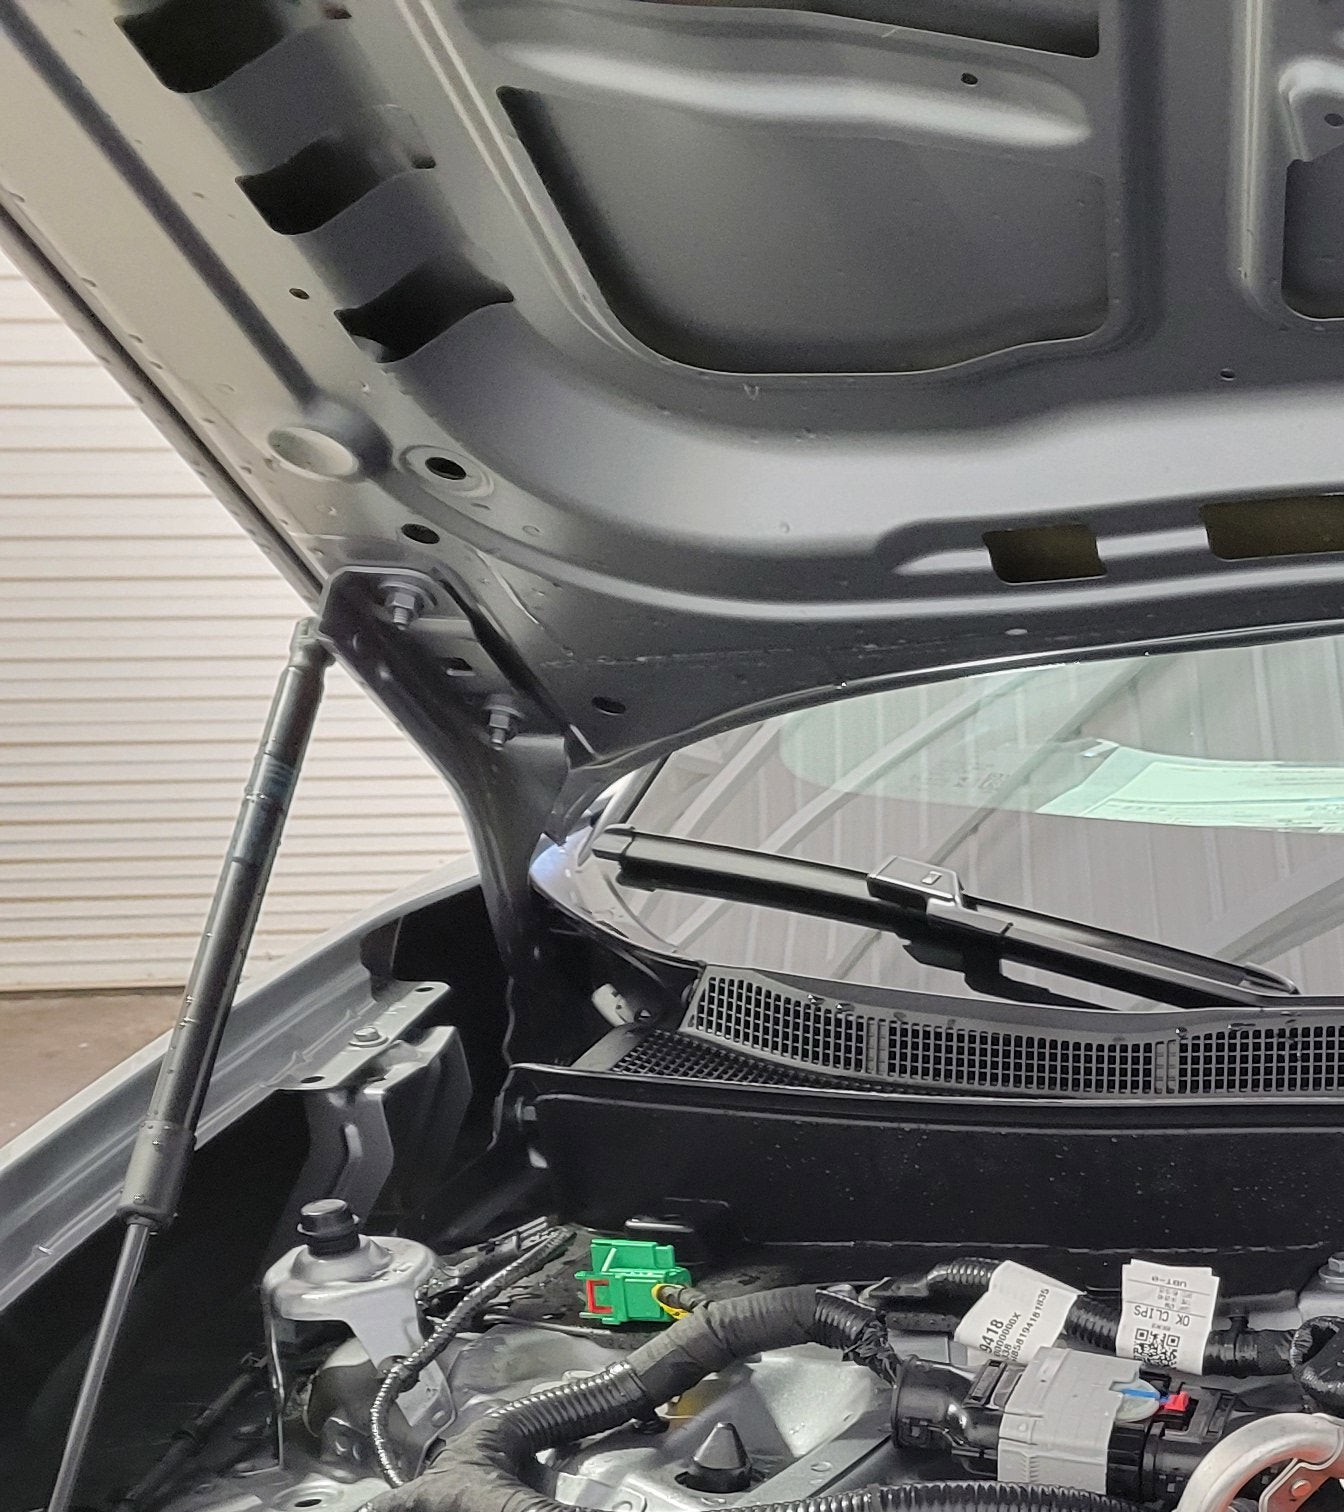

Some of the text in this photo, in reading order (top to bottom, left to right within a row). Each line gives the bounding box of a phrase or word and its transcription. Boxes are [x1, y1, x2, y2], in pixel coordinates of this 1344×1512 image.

[1134, 1305, 1170, 1322] CLIPS
[1175, 1313, 1191, 1327] OK
[980, 1319, 1004, 1354] 9418
